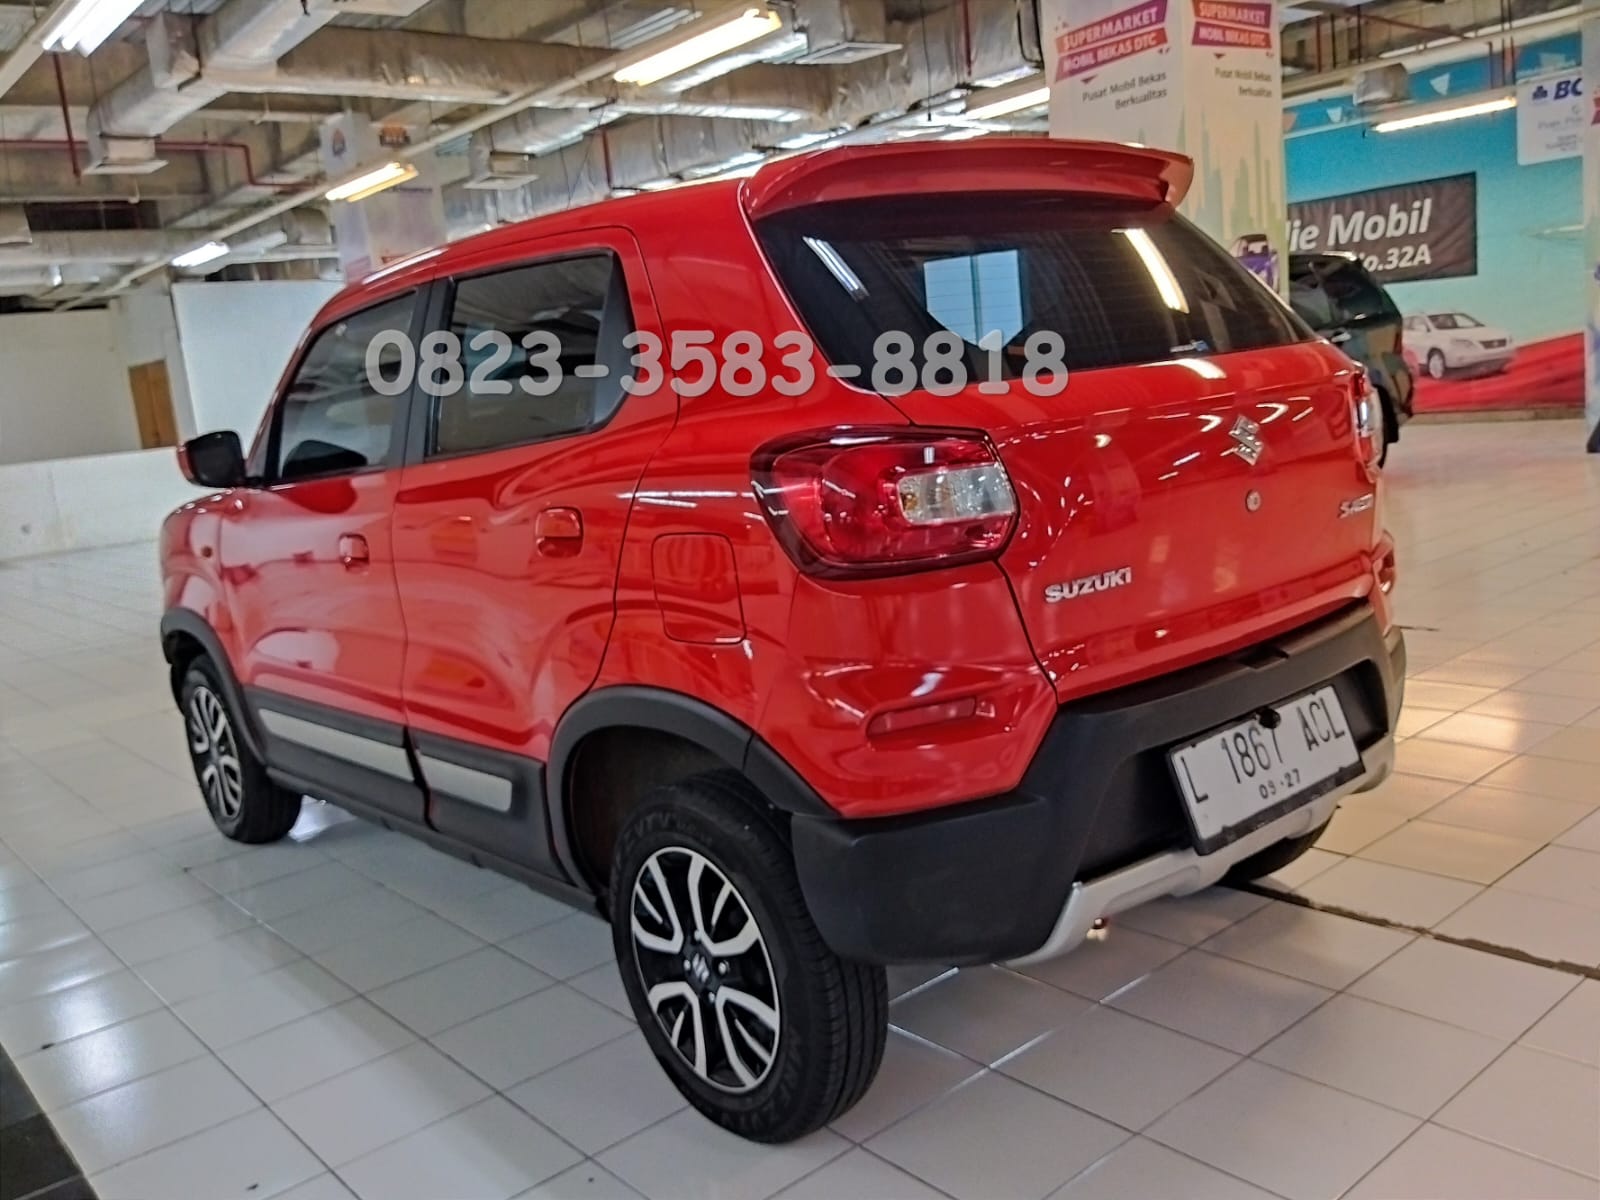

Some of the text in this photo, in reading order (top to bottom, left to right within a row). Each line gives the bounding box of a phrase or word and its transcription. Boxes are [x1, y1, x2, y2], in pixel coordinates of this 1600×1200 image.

[1063, 6, 1158, 51] SUPERMARKET
[1199, 1, 1266, 25] SUPERMARKET
[1063, 32, 1157, 72] MOBIL BEKAS DTC
[1082, 71, 1167, 102] Pusat Mobil Bekas
[1115, 88, 1168, 110] Berkualitas
[1327, 198, 1432, 246] Mobil
[1357, 243, 1432, 273] o.32A
[1045, 567, 1132, 604] SUZUKI
[1180, 697, 1345, 804] L 1867 ACL
